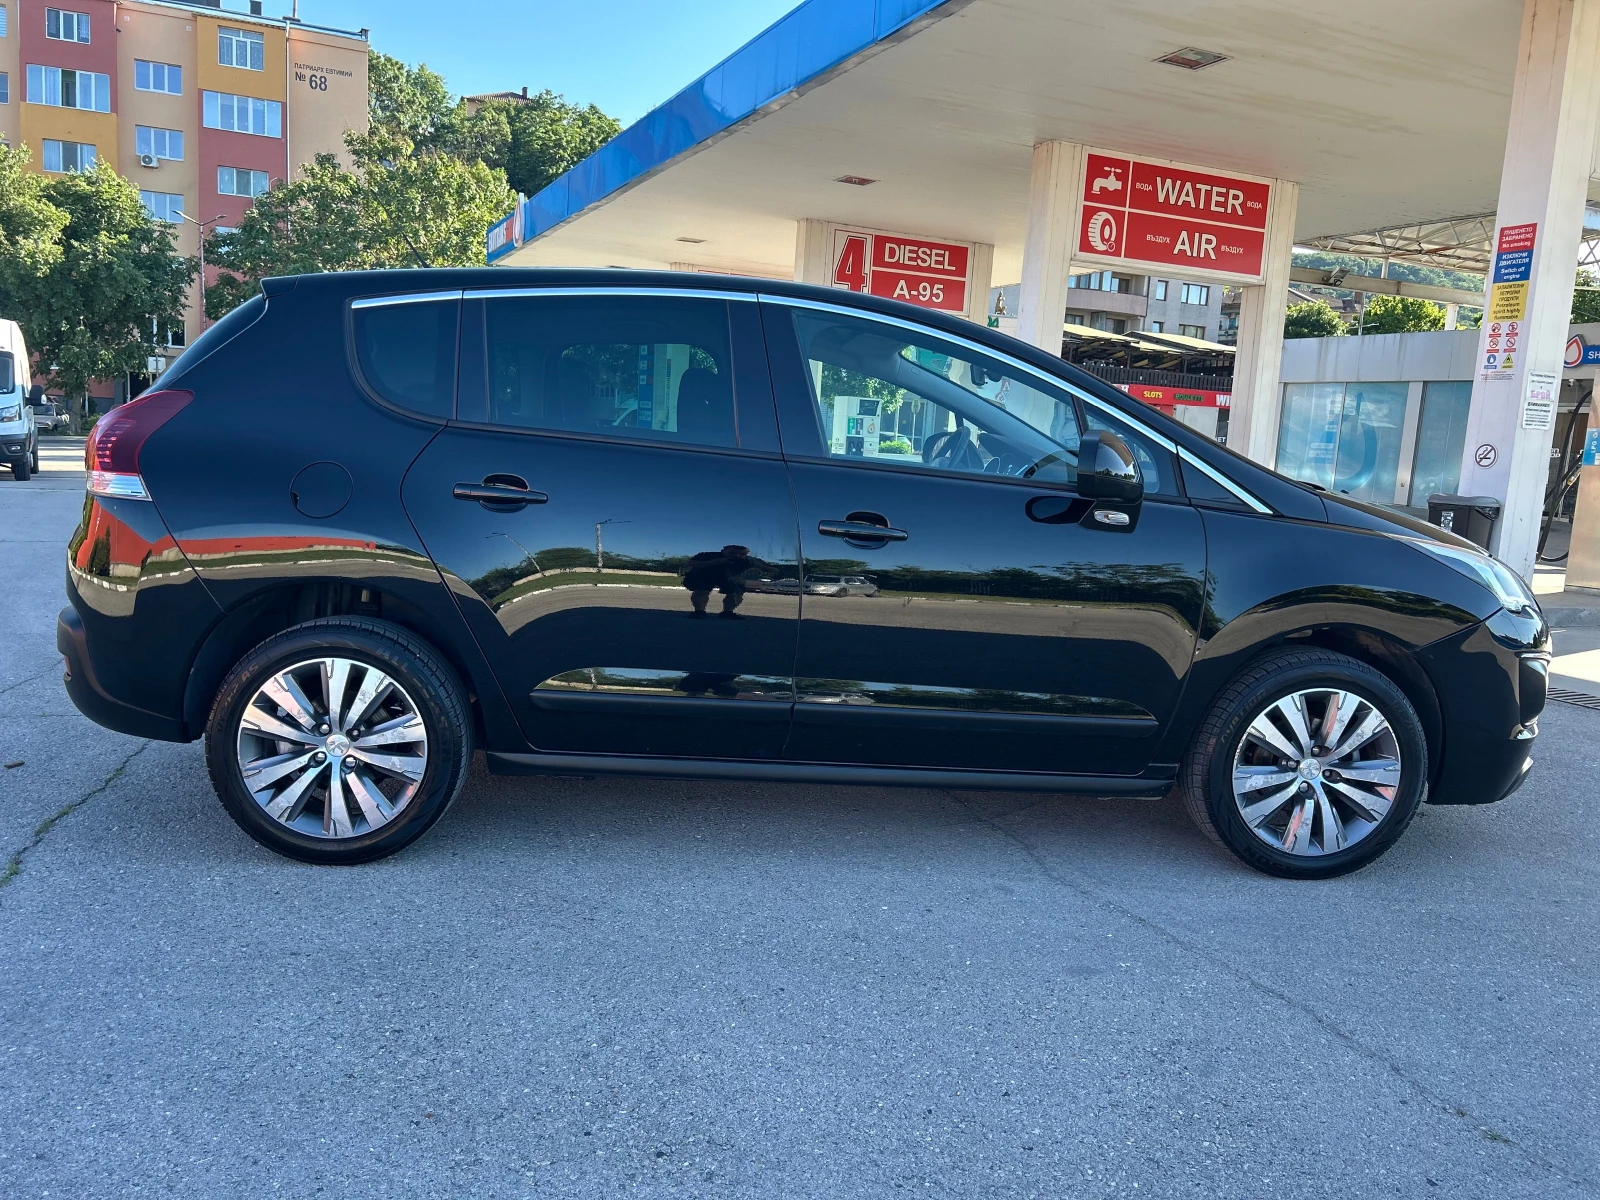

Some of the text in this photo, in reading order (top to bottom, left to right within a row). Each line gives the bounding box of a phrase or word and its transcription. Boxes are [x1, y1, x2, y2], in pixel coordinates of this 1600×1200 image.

[294, 63, 353, 78] ПАТРИАРХ ЕВТИМИЙ
[309, 74, 328, 92] 68
[1135, 176, 1263, 216] ВОДА WATER ВОДА
[1146, 230, 1244, 260] ВЪЗДУХ AIR ВЪЗДУХ
[1510, 240, 1531, 248] smoking
[834, 235, 868, 294] 4
[884, 242, 956, 271] DIESEL
[892, 279, 944, 303] A-95
[1143, 390, 1163, 399] SLOTS
[1173, 393, 1205, 402] ROULETTE
[375, 647, 409, 674] ALL
